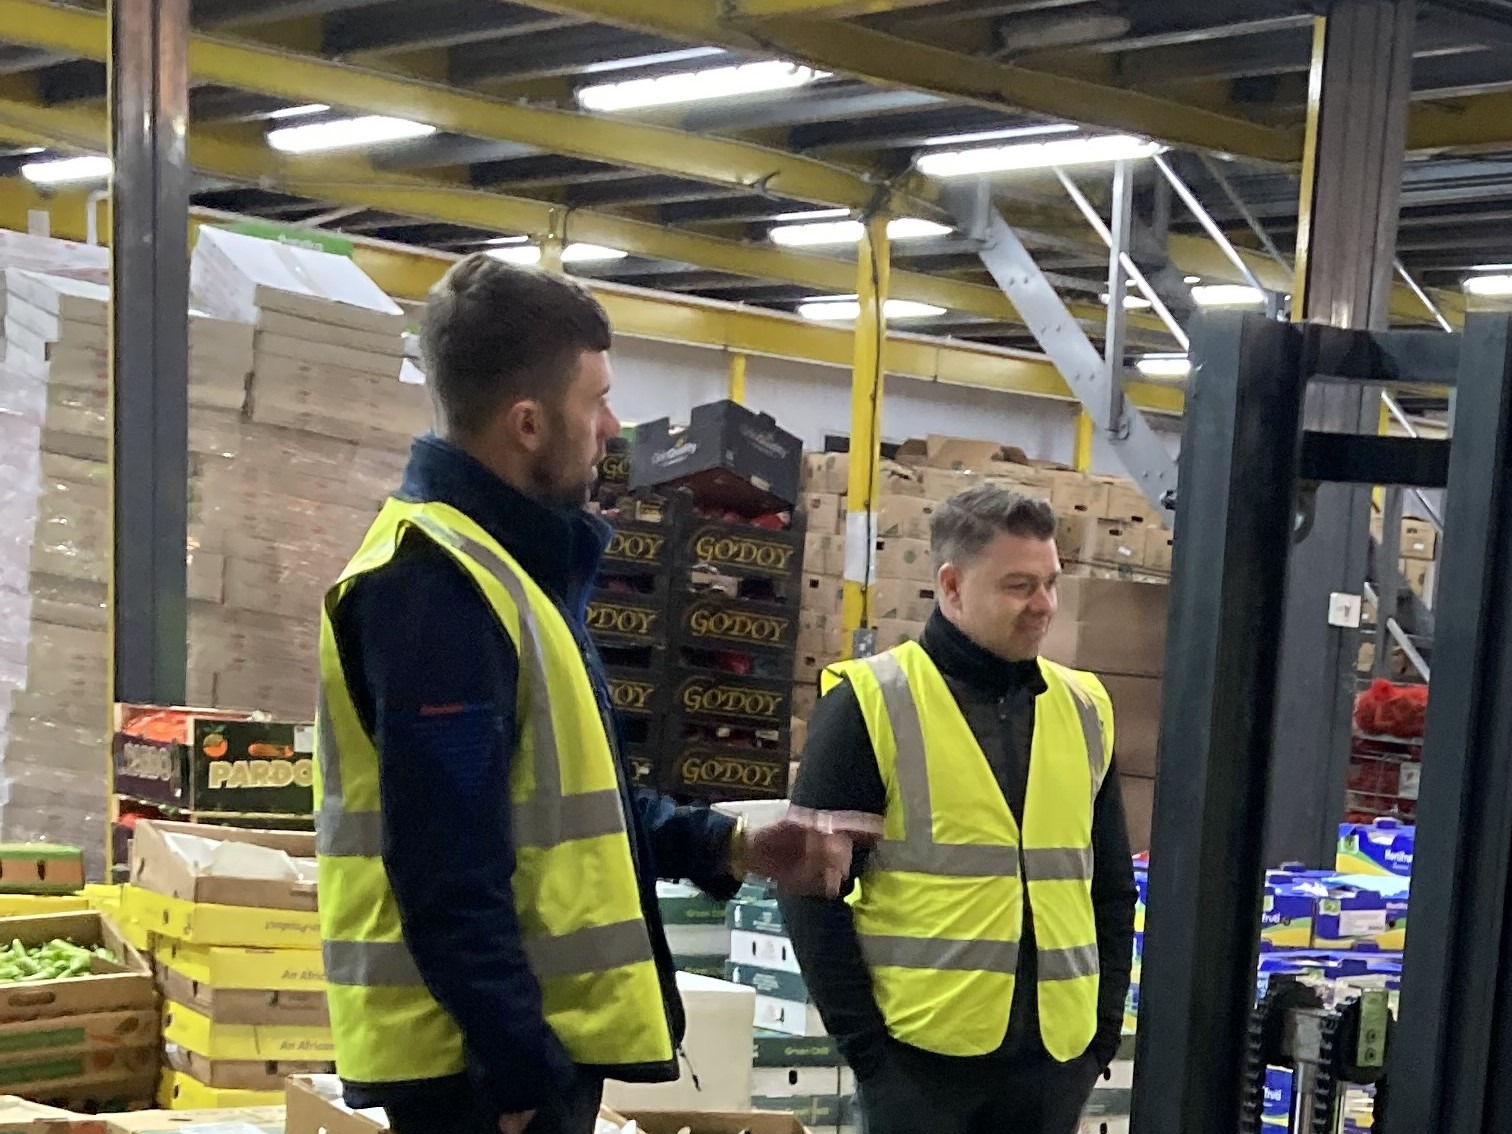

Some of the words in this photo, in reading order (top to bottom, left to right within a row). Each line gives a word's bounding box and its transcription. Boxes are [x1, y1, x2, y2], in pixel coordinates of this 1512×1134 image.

[604, 534, 664, 559] DOY
[696, 536, 794, 569] GODOY
[586, 606, 656, 633] DOY
[690, 610, 788, 641] GODOY
[683, 686, 783, 716] GODOY
[208, 759, 313, 789] PARDO
[682, 758, 780, 786] GODOY
